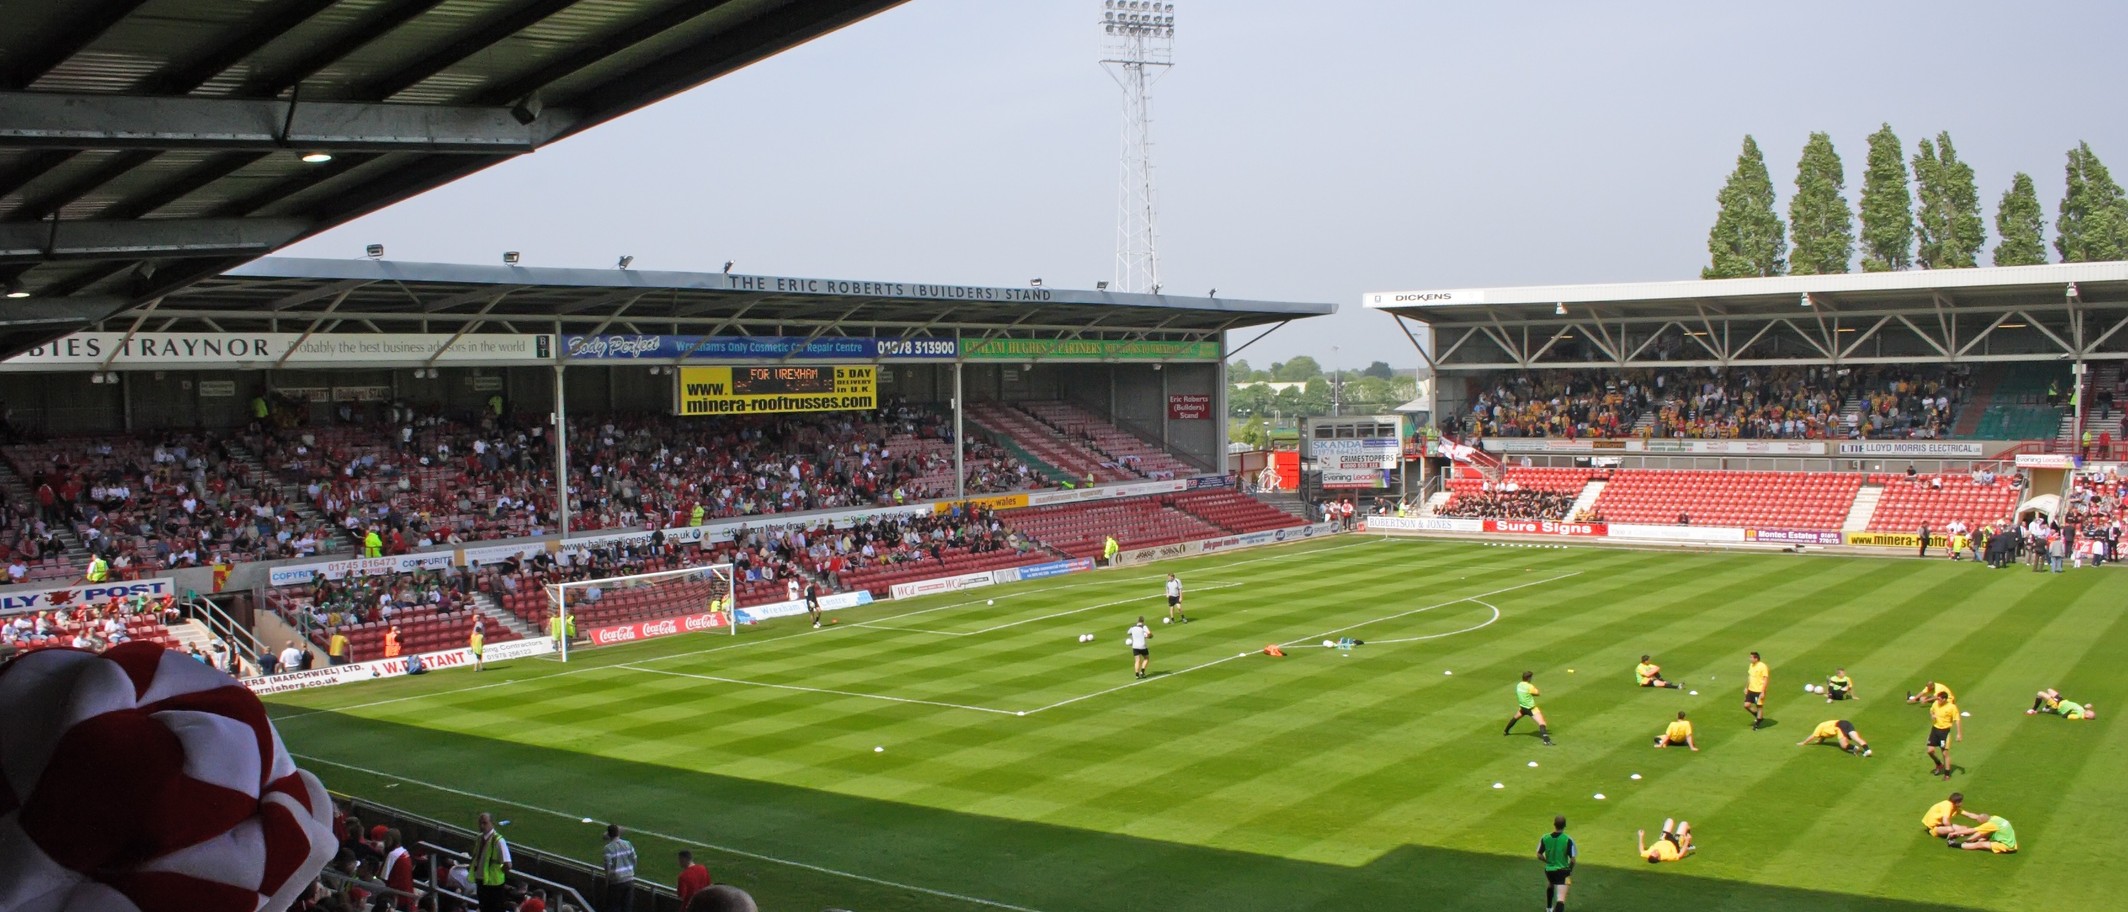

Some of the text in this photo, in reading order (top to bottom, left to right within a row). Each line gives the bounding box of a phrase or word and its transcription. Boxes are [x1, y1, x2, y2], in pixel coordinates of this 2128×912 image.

[729, 275, 1051, 301] THE ERIC ROBERTS (BUILDERS) STAND
[1395, 293, 1452, 302] DICKENS
[118, 338, 269, 357] TRAYNOR
[339, 340, 357, 353] the
[359, 340, 381, 353] best
[383, 341, 424, 354] business
[469, 341, 477, 352] in
[480, 342, 496, 352] the
[499, 341, 526, 353] world
[608, 335, 661, 358] Perfect
[676, 341, 726, 353] Wreham's
[728, 342, 747, 354] Only
[749, 342, 789, 354] Cosmetic
[807, 343, 834, 354] Repair
[836, 343, 862, 353] Centre
[915, 340, 955, 355] 313900
[751, 369, 770, 380] FOR
[837, 370, 845, 378] 5
[848, 370, 871, 378] DAY
[687, 384, 728, 396] www.
[687, 396, 873, 413] minera-rooftrusses.com
[1866, 444, 1892, 452] LLOYD
[1894, 445, 1926, 453] MORRIS
[1929, 445, 1972, 453] ELECTRICAL
[1340, 455, 1394, 463] CRIMESTOPPERS
[1323, 473, 1352, 482] Evening
[996, 497, 1017, 506] wales
[1369, 518, 1416, 527] ROBERTSON
[1427, 520, 1452, 528] JONES
[1497, 521, 1536, 532] Sure
[1541, 522, 1592, 535] Signs
[328, 558, 397, 572] 01745 816473
[272, 570, 318, 581] COPYRIT
[0, 582, 166, 610] LY POST
[761, 603, 800, 615] Wrexham
[820, 596, 848, 607] Centre
[642, 620, 677, 637] Coca-Cola
[686, 614, 719, 630] Coca-Cola
[599, 626, 635, 643] Coca-Cola
[504, 640, 543, 650] Contractors
[269, 668, 340, 684] (MARCHWIEL)
[343, 664, 364, 673] LTD.
[252, 678, 338, 695] urnishers.co.uk
